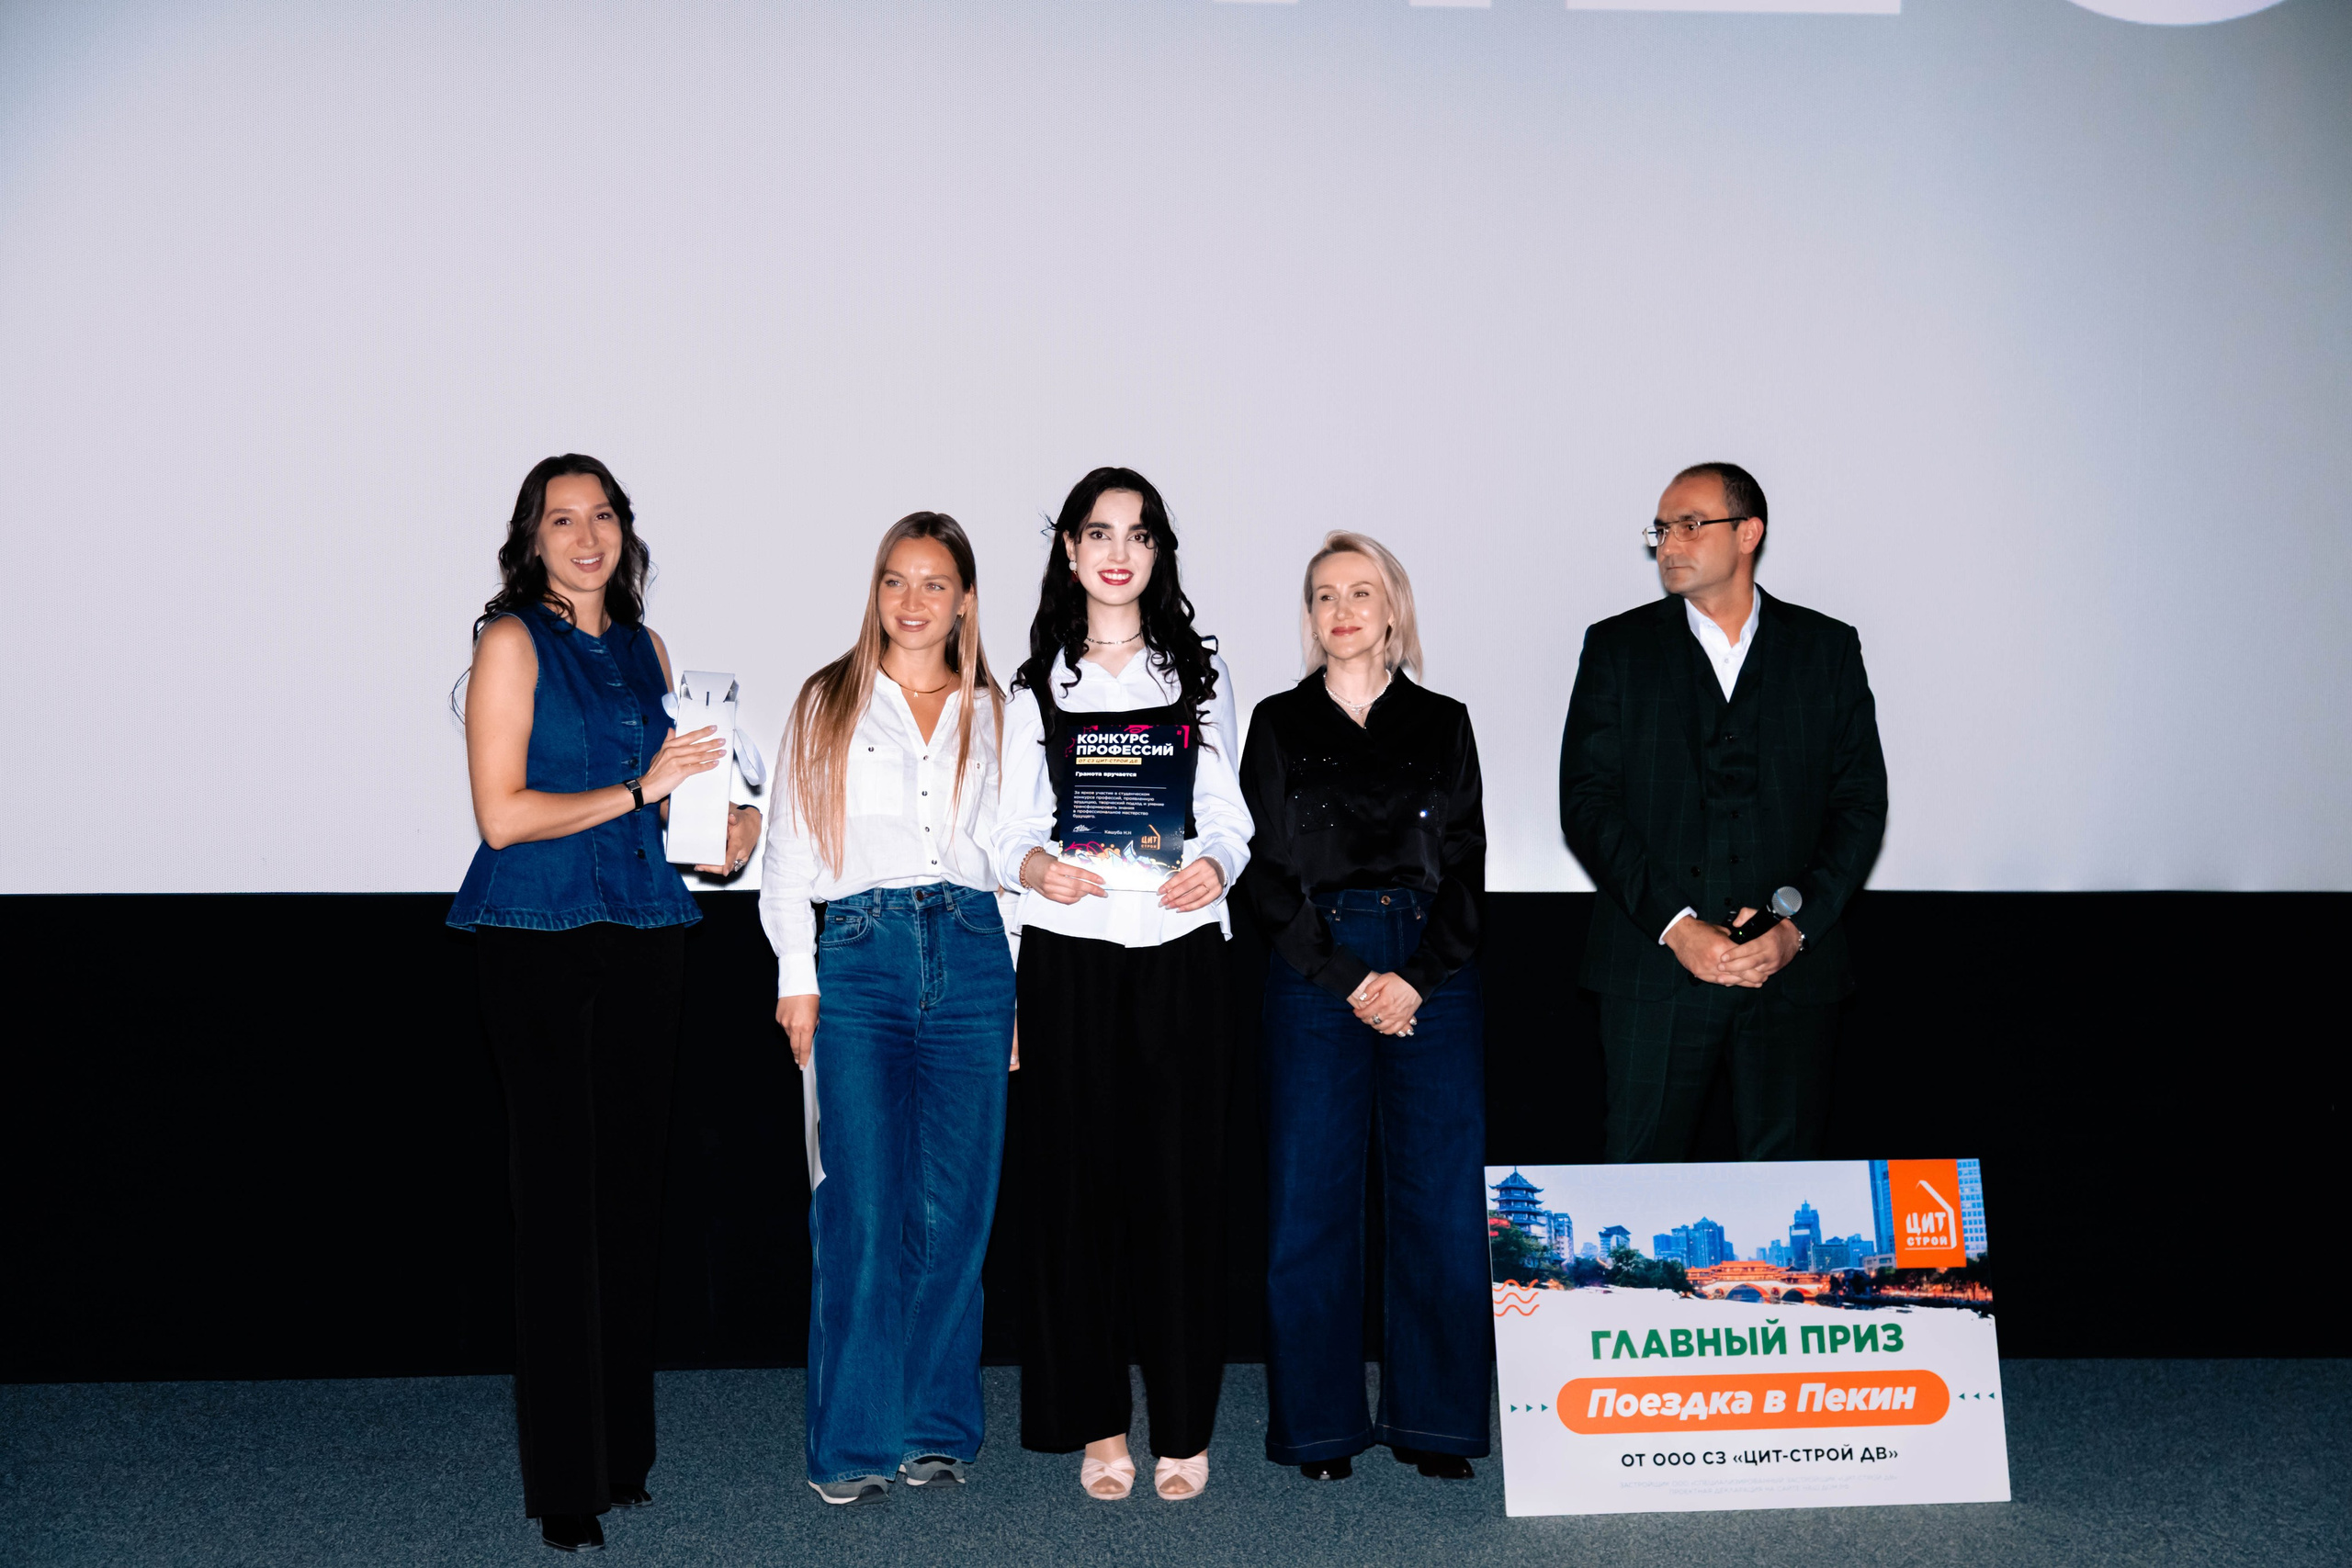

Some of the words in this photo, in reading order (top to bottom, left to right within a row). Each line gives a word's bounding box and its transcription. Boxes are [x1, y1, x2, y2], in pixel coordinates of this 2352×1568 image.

[1076, 743, 1174, 756] ПРОФЕССИЙ
[1077, 734, 1149, 744] КОНКУРС
[1905, 1212, 1947, 1235] ЦИТ
[1906, 1235, 1948, 1247] СТРОЙ
[1591, 1318, 1788, 1359] ГЛАВНЫЙ
[1802, 1323, 1905, 1355] ПРИЗ
[1587, 1388, 1753, 1421] Поездка
[1763, 1390, 1787, 1414] в
[1796, 1382, 1917, 1412] Пекин
[1621, 1453, 1645, 1467] ОТ
[1652, 1451, 1696, 1466] ООО
[1702, 1450, 1726, 1465] СЗ
[1733, 1444, 1853, 1465] «ЦИТ-СТРОЙ
[1860, 1447, 1898, 1463] ДВ»
